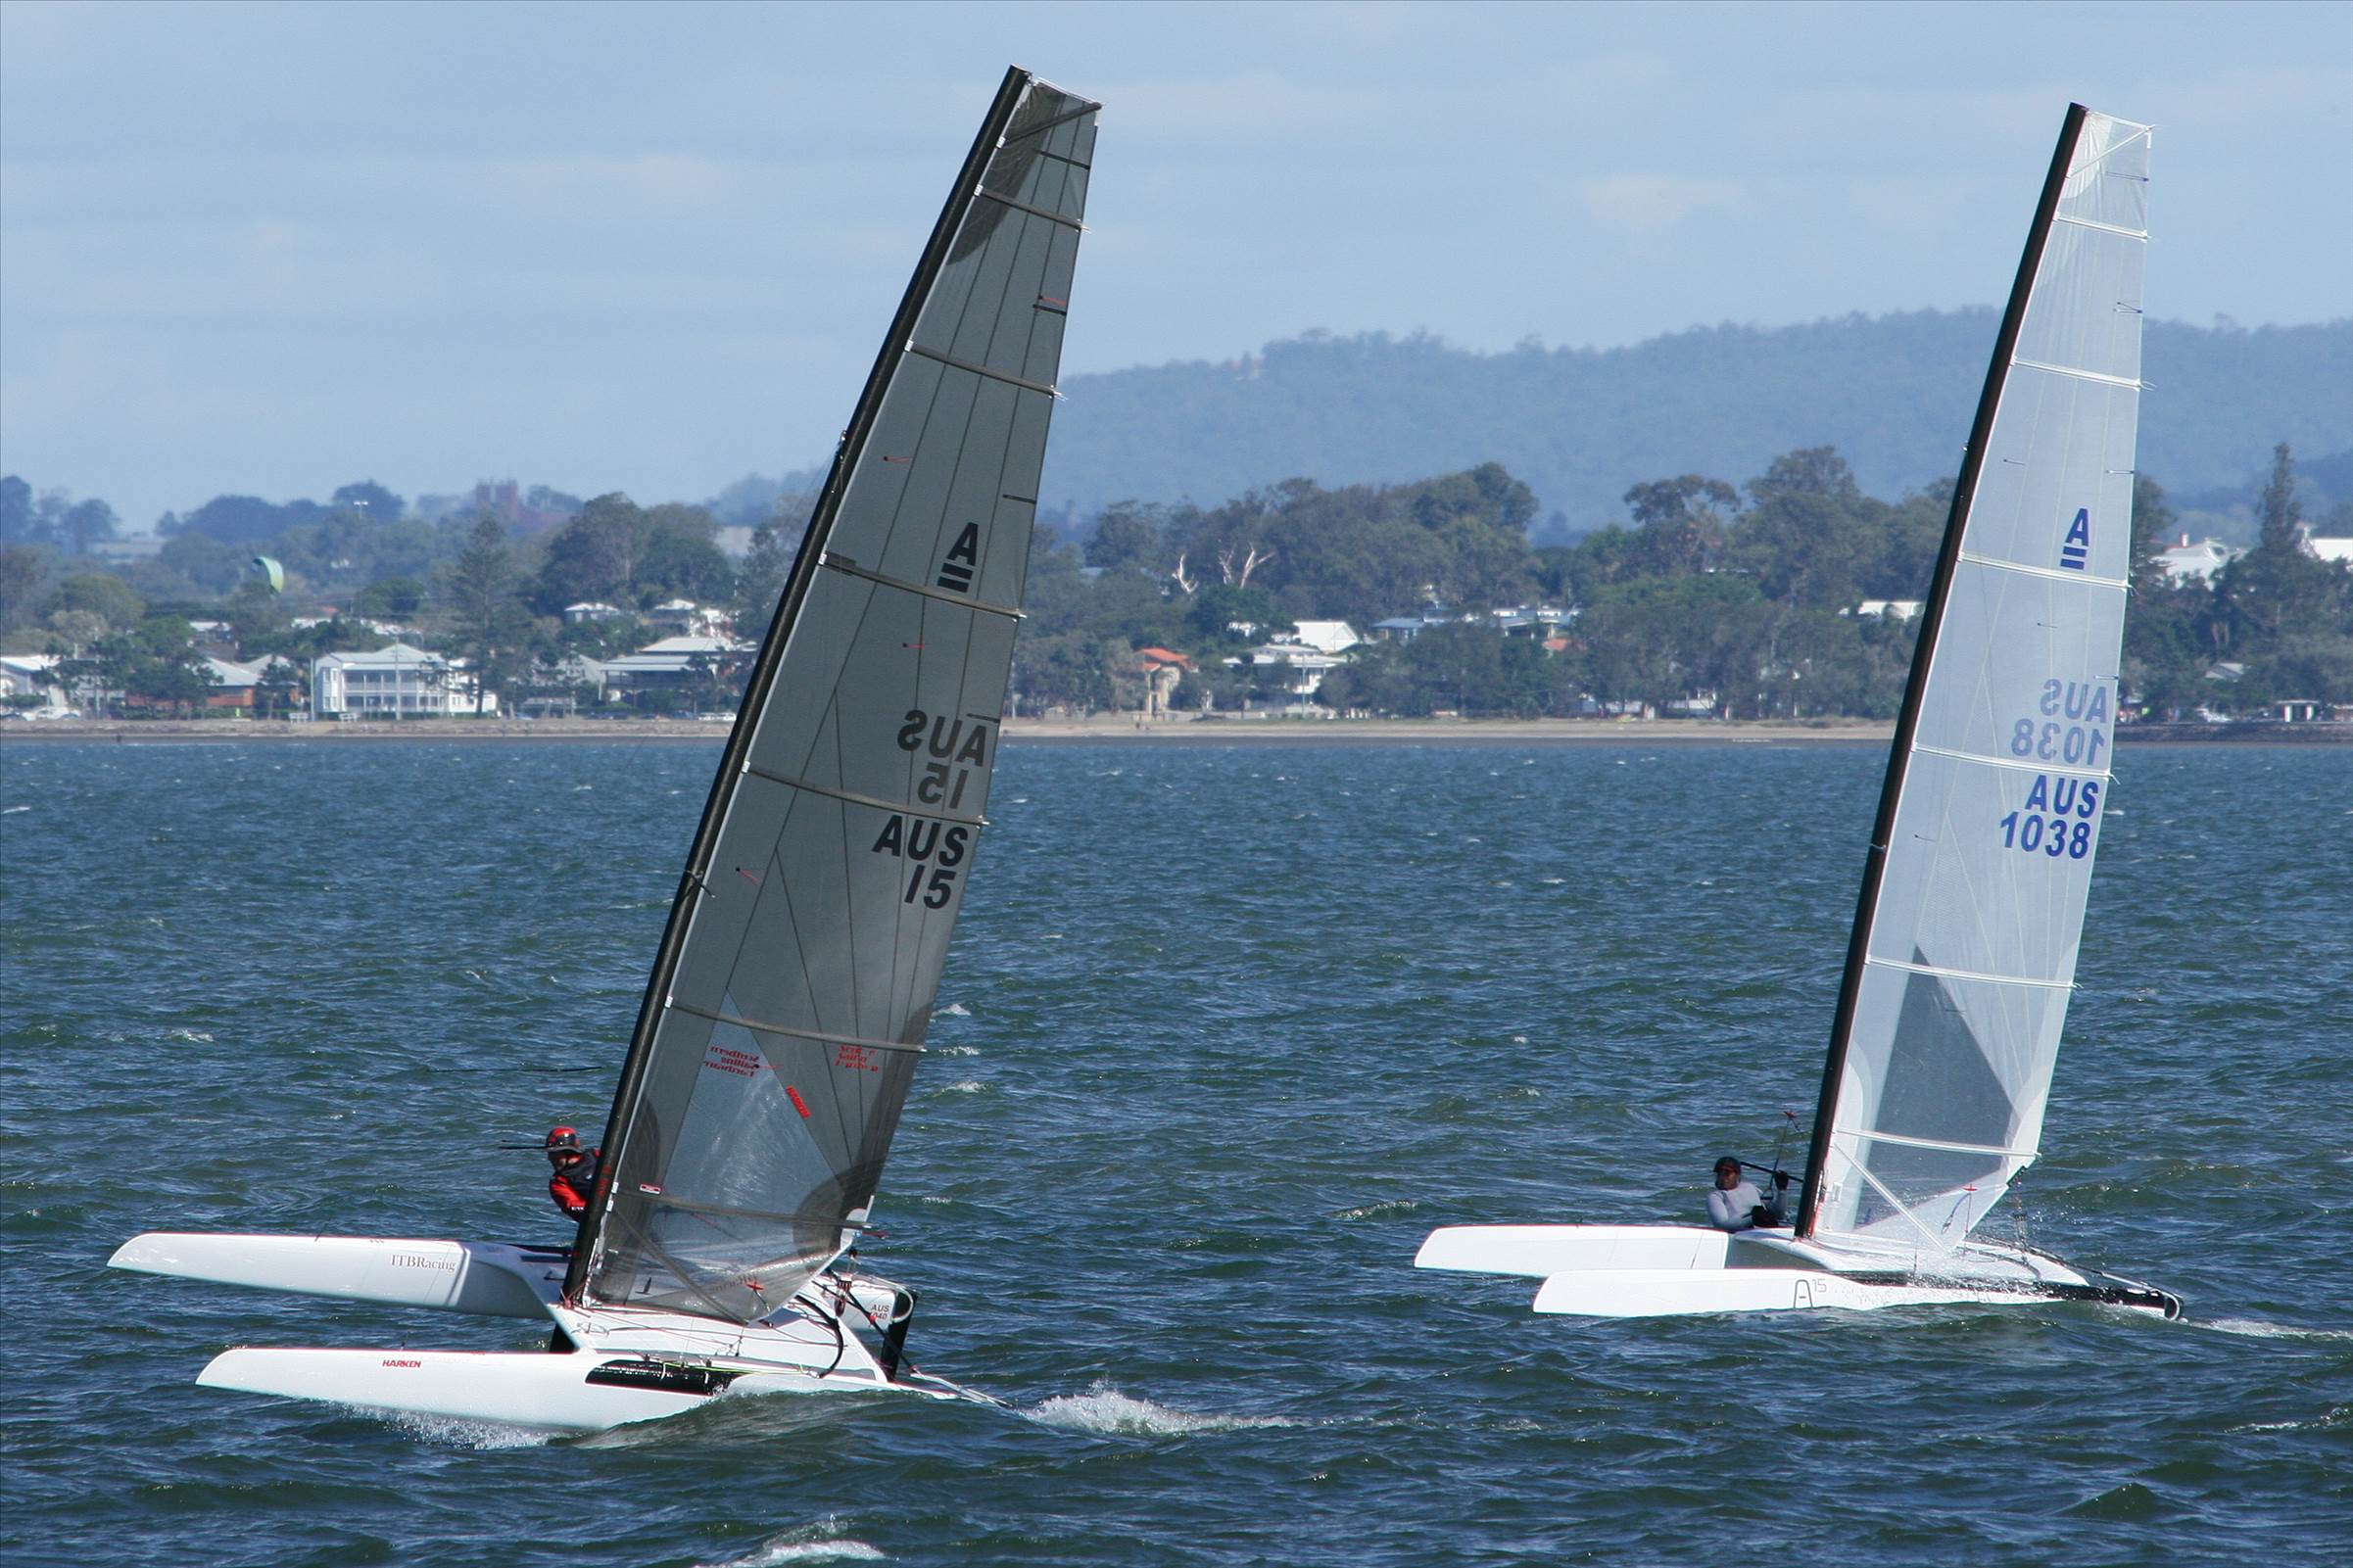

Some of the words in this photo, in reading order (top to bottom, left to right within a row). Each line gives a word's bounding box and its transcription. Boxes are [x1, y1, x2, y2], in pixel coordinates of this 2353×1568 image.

[947, 522, 979, 566] A
[2064, 507, 2089, 546] A
[2024, 774, 2098, 819] AUS
[872, 814, 968, 868] AUS
[1999, 811, 2090, 860] 1038
[904, 864, 957, 911] 15
[872, 1304, 889, 1312] AUS
[382, 1359, 421, 1368] HARKEN
